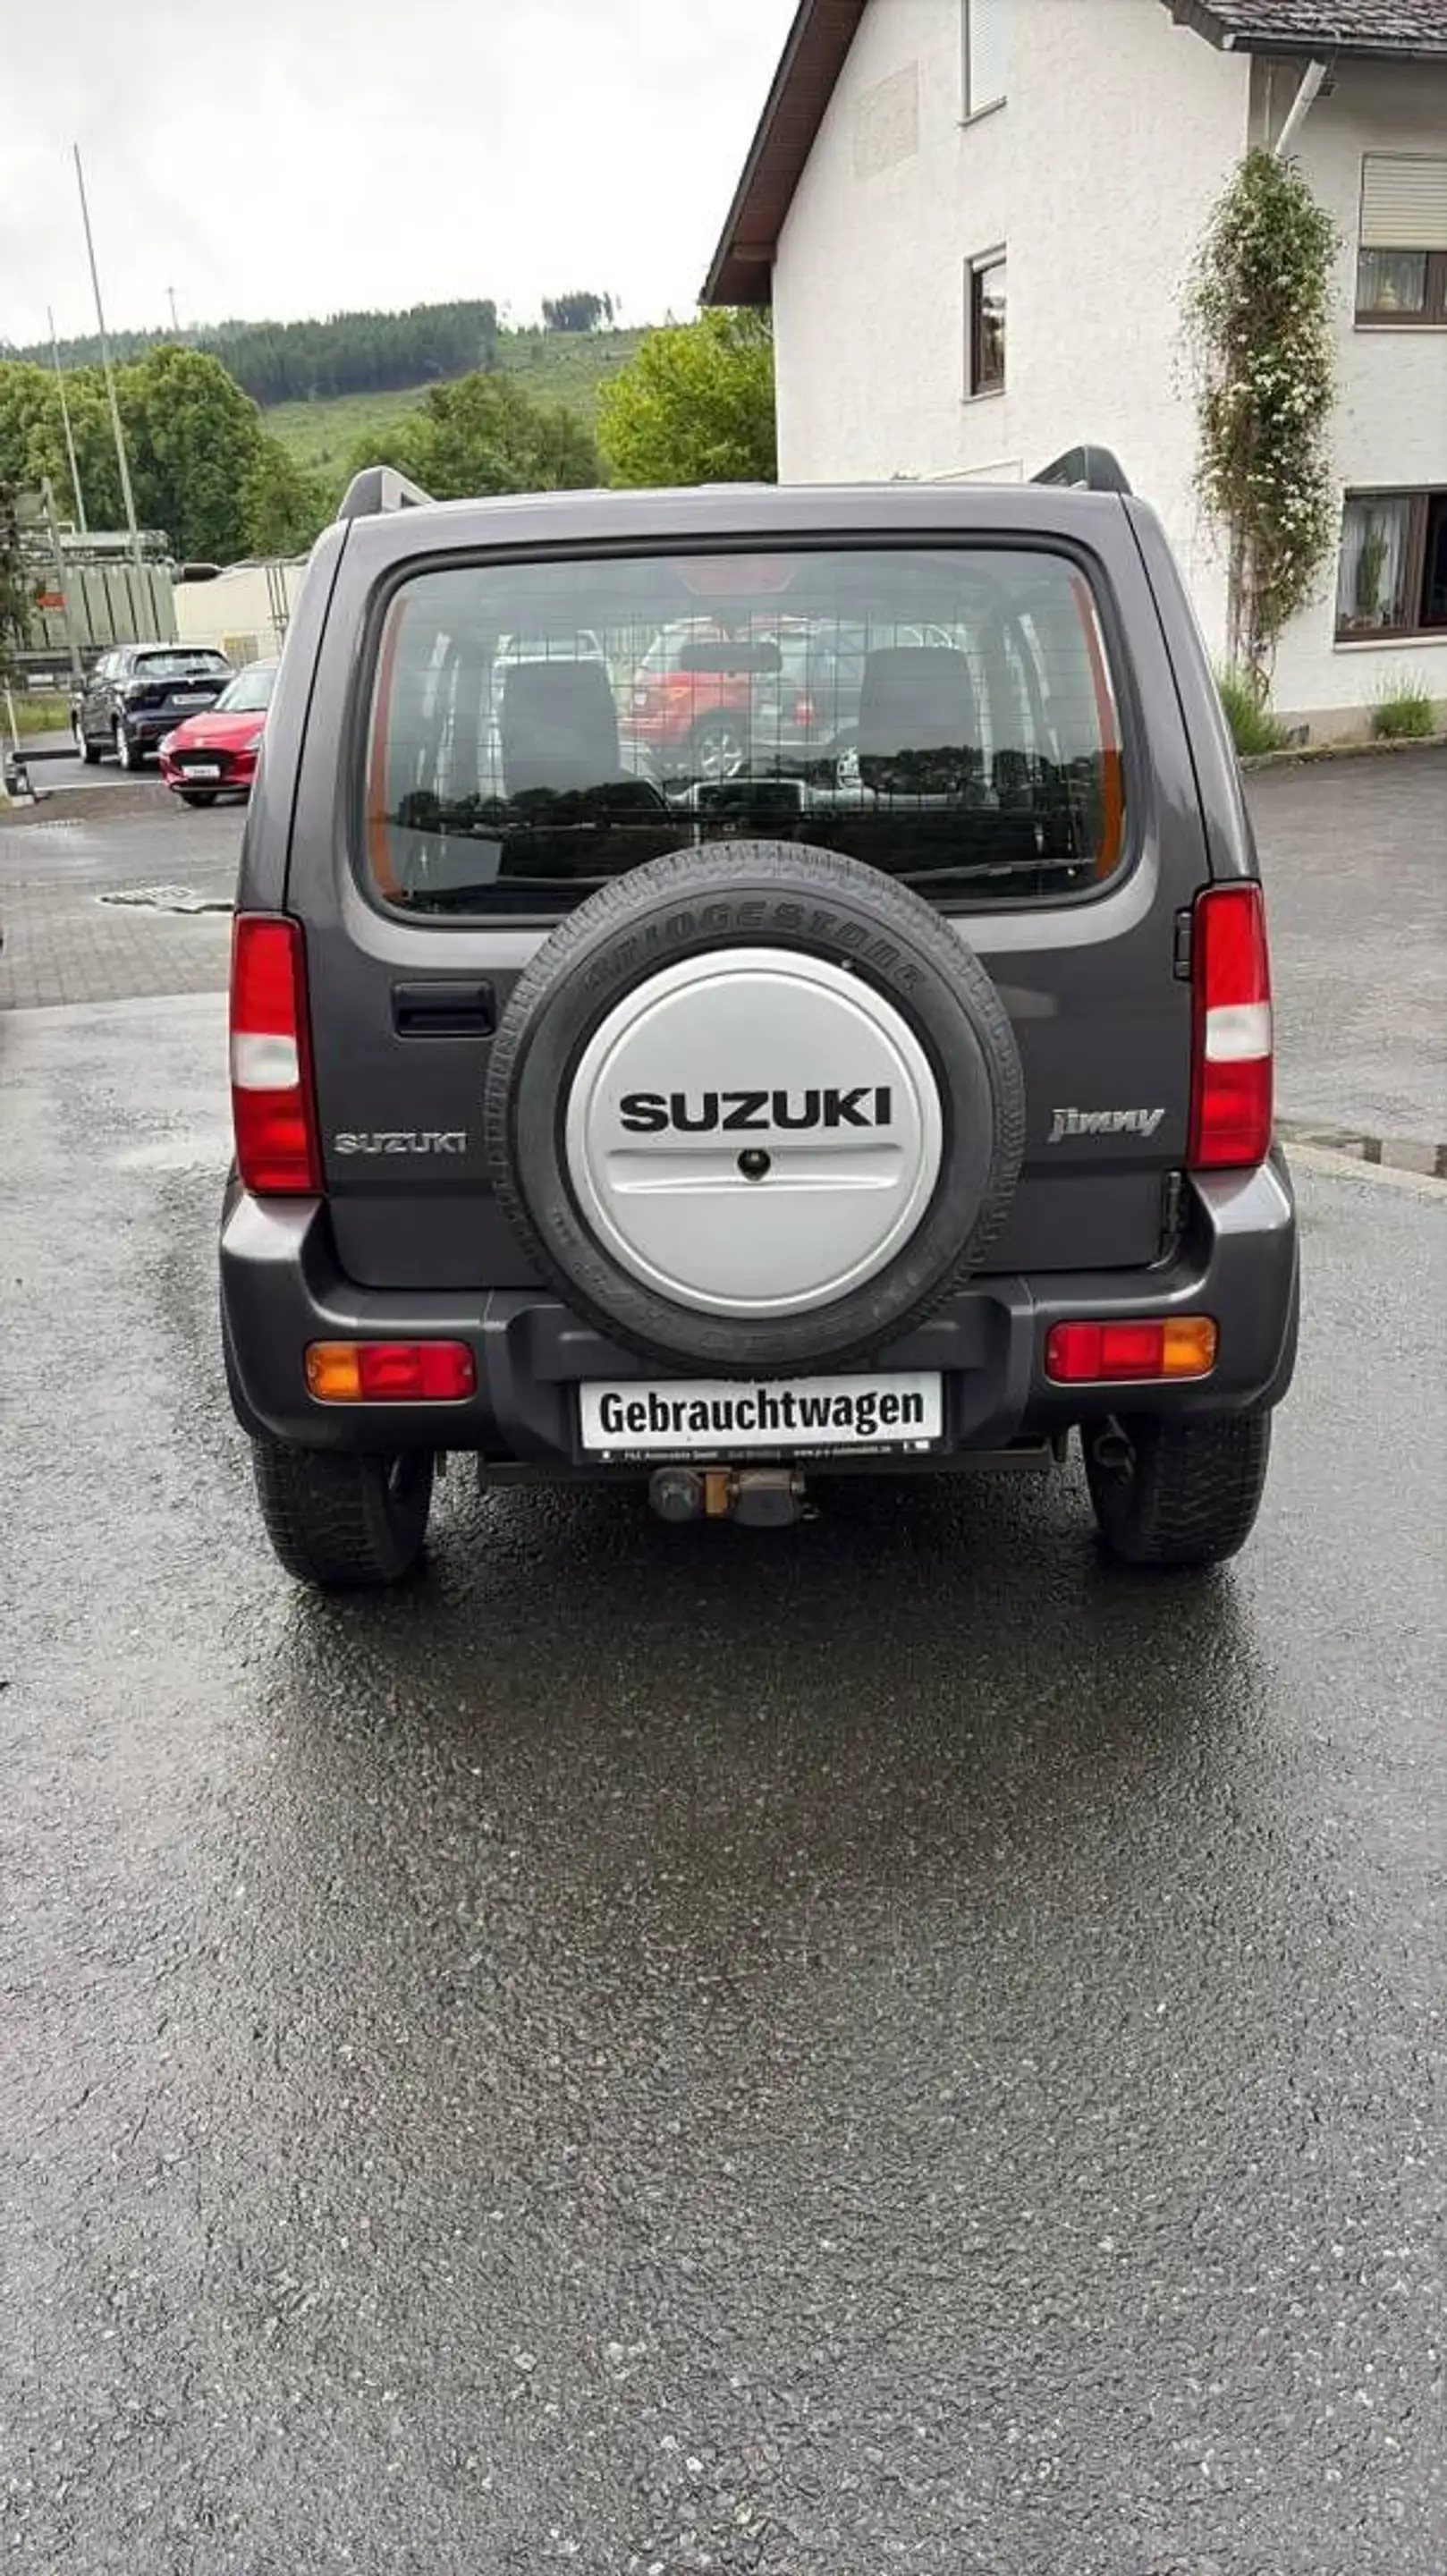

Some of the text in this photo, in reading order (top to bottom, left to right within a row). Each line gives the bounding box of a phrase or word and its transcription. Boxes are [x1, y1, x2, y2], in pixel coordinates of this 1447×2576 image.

[619, 1086, 892, 1133] SUZUKI
[334, 1132, 468, 1154] SUZUKI
[599, 1388, 925, 1436] Gebrauchtwagen
